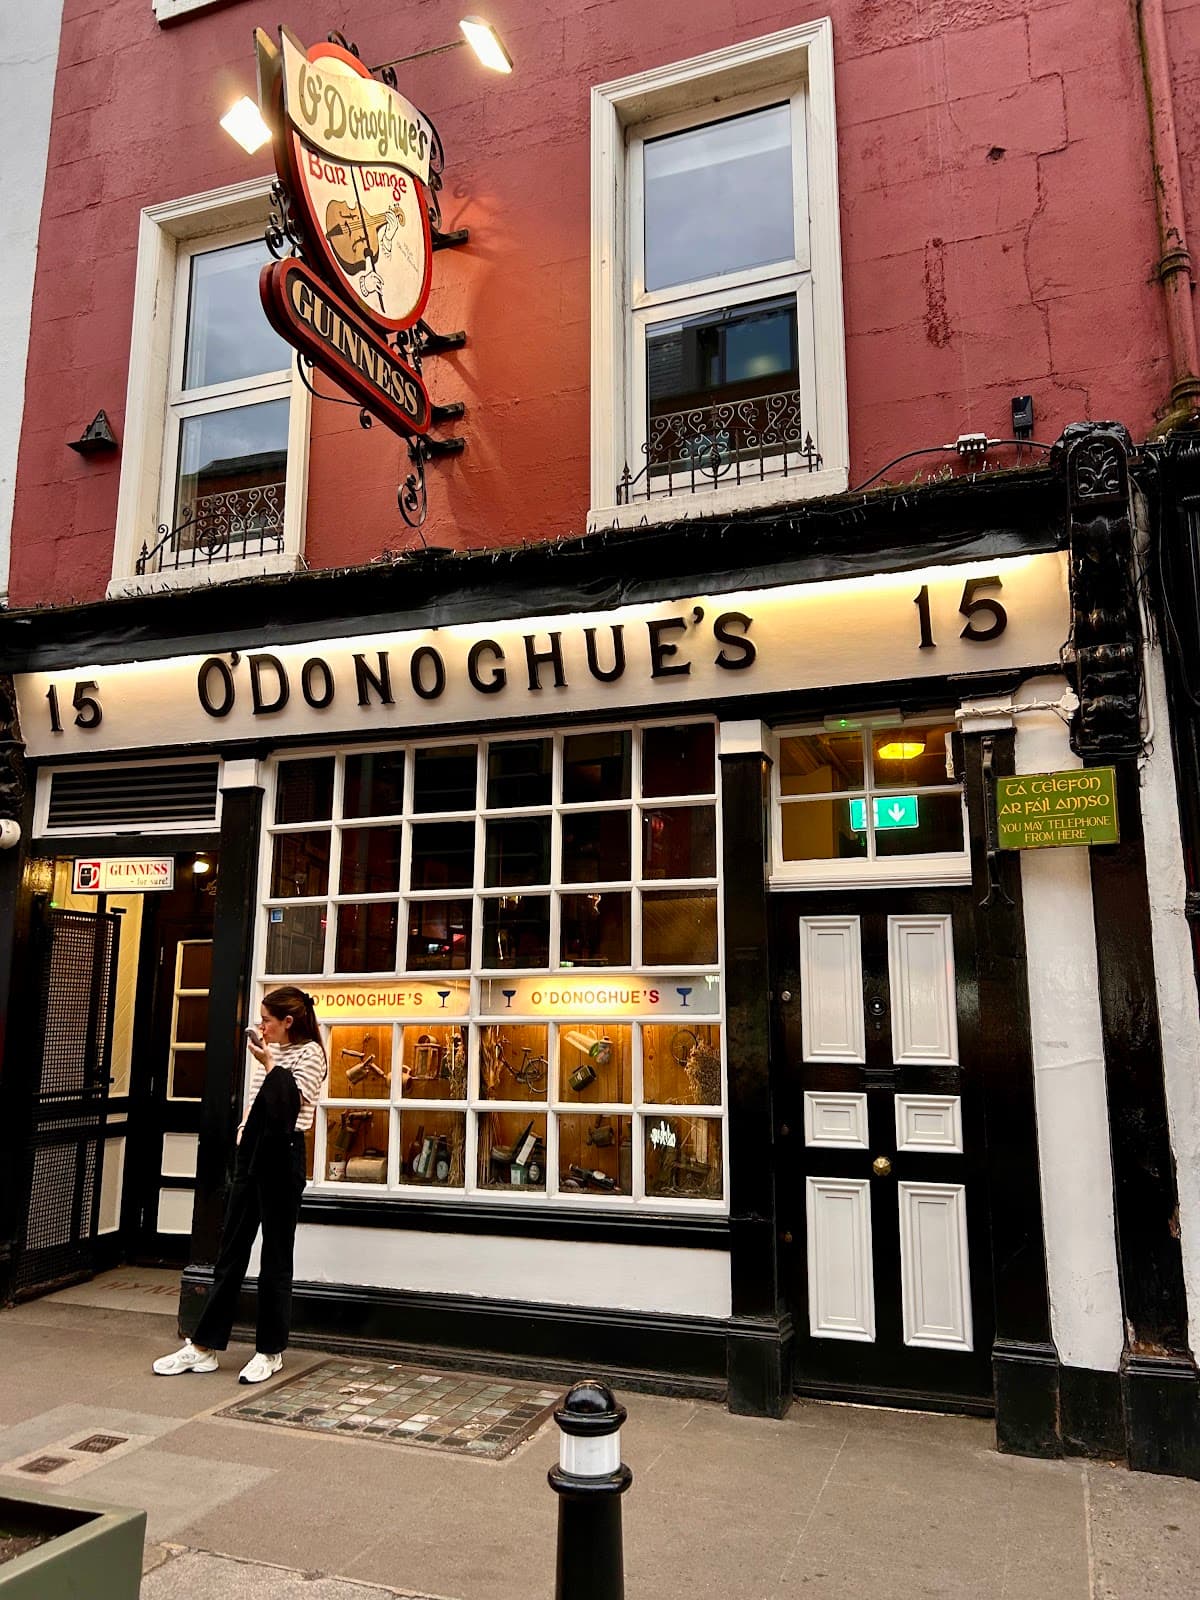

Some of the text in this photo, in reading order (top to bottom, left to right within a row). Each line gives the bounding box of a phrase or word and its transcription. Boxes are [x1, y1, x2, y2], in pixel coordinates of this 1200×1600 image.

[298, 63, 428, 161] O'Donoghue's
[357, 165, 407, 202] Lounge
[292, 279, 418, 416] GUINNESS
[46, 575, 1008, 732] 15 O'DONOGHUE'S 15
[1001, 816, 1111, 833] YOU MAY TELEPHONE
[1024, 829, 1087, 842] FROM HERE
[110, 863, 168, 876] GUINNESS
[312, 992, 423, 1007] O'DONOGHUE'S
[531, 990, 660, 1005] O'DONOGHUE'S
